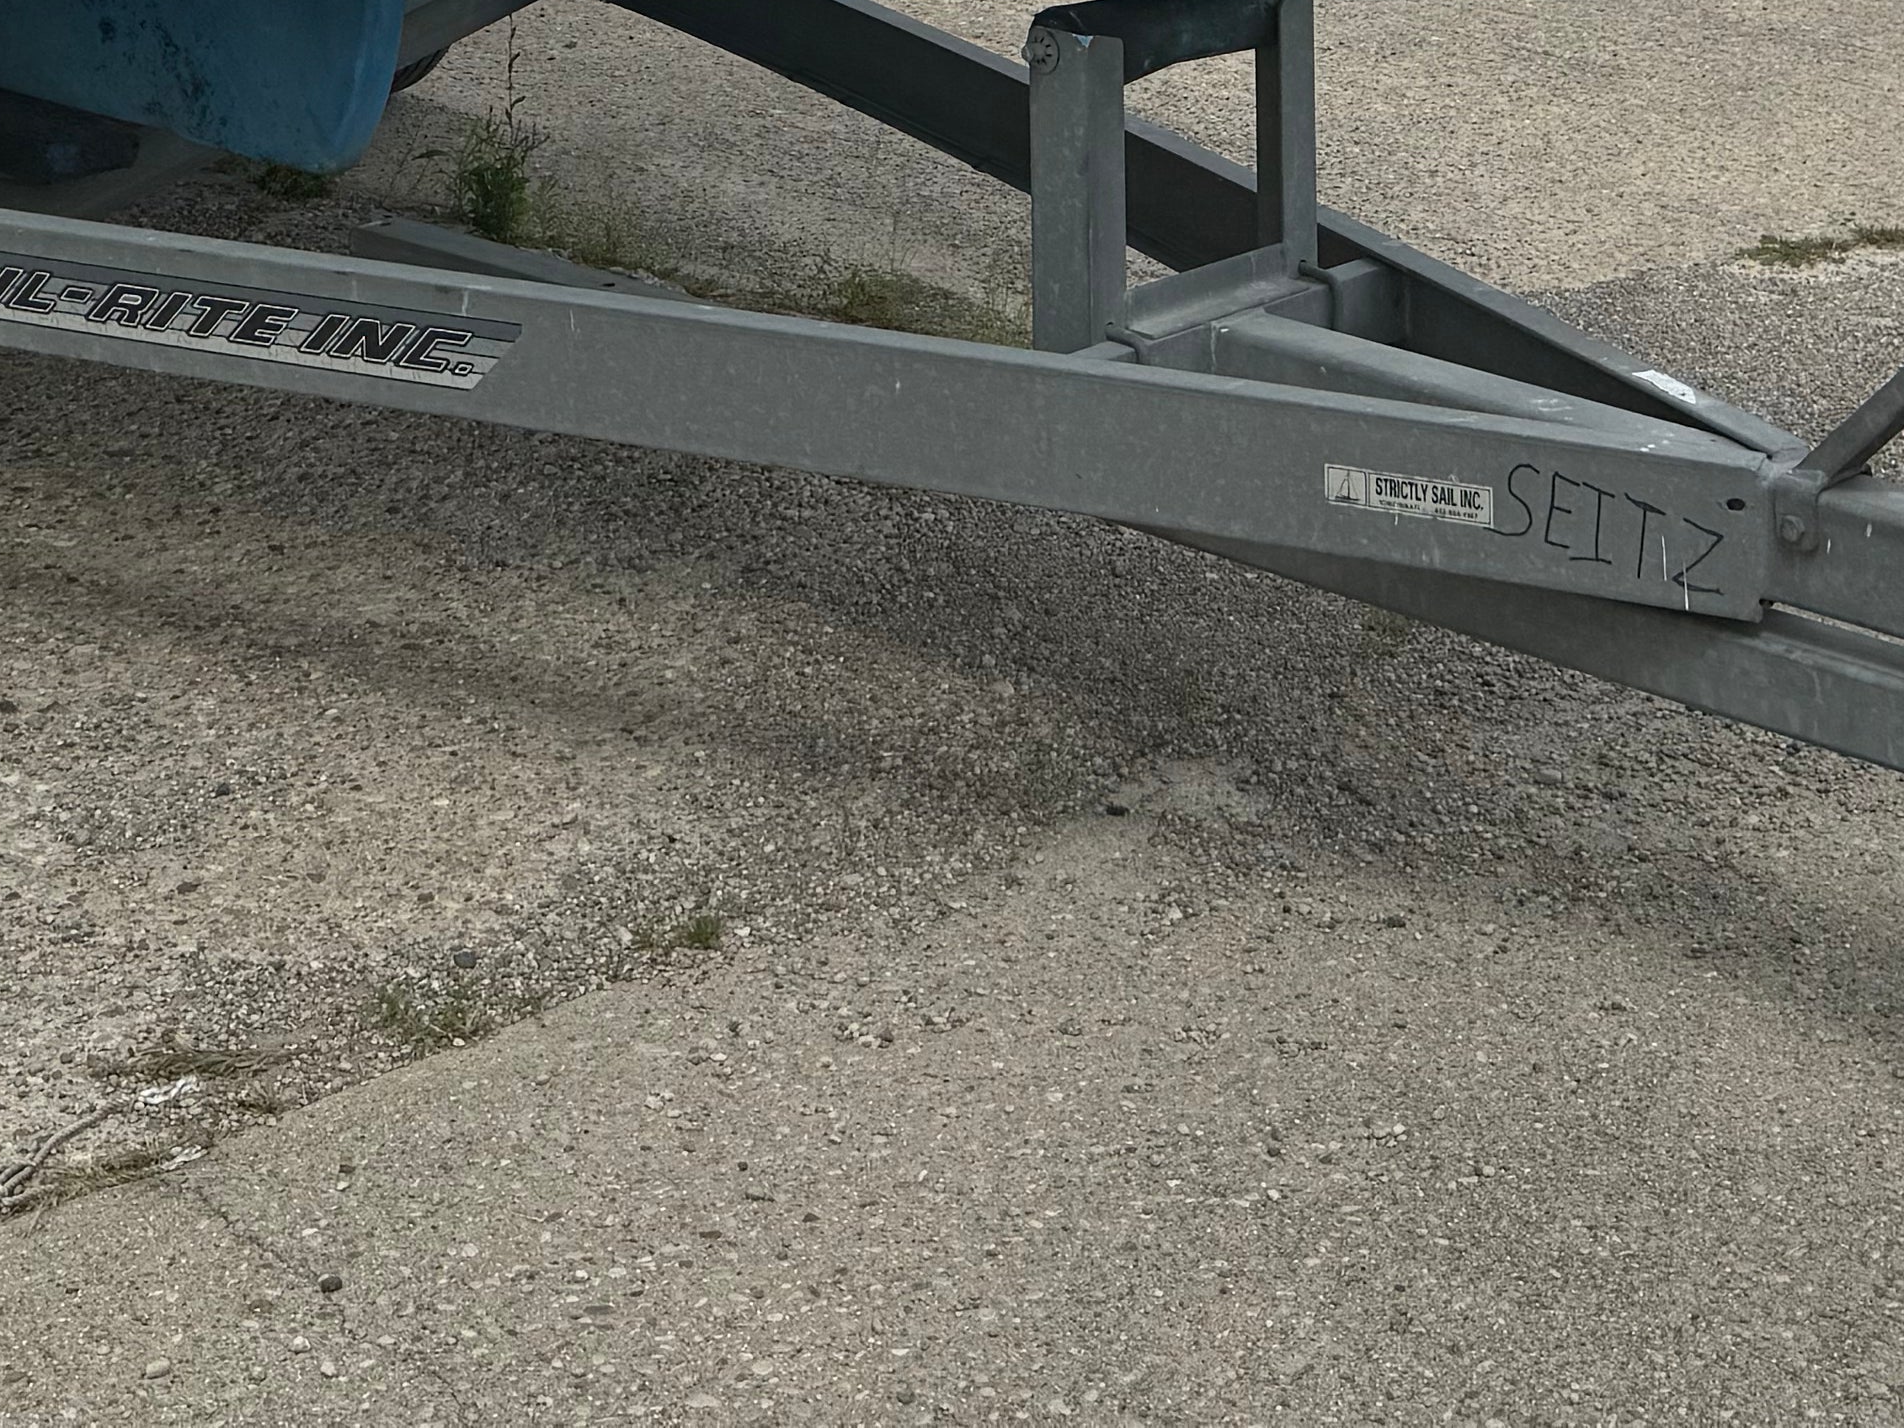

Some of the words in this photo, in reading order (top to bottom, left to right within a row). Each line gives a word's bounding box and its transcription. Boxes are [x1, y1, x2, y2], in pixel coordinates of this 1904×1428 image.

[298, 314, 476, 376] INC.
[1375, 477, 1429, 503] STRICTLY
[1431, 485, 1458, 507] SAIL
[1460, 489, 1484, 511] INC.
[1483, 462, 1726, 596] SEITZ
